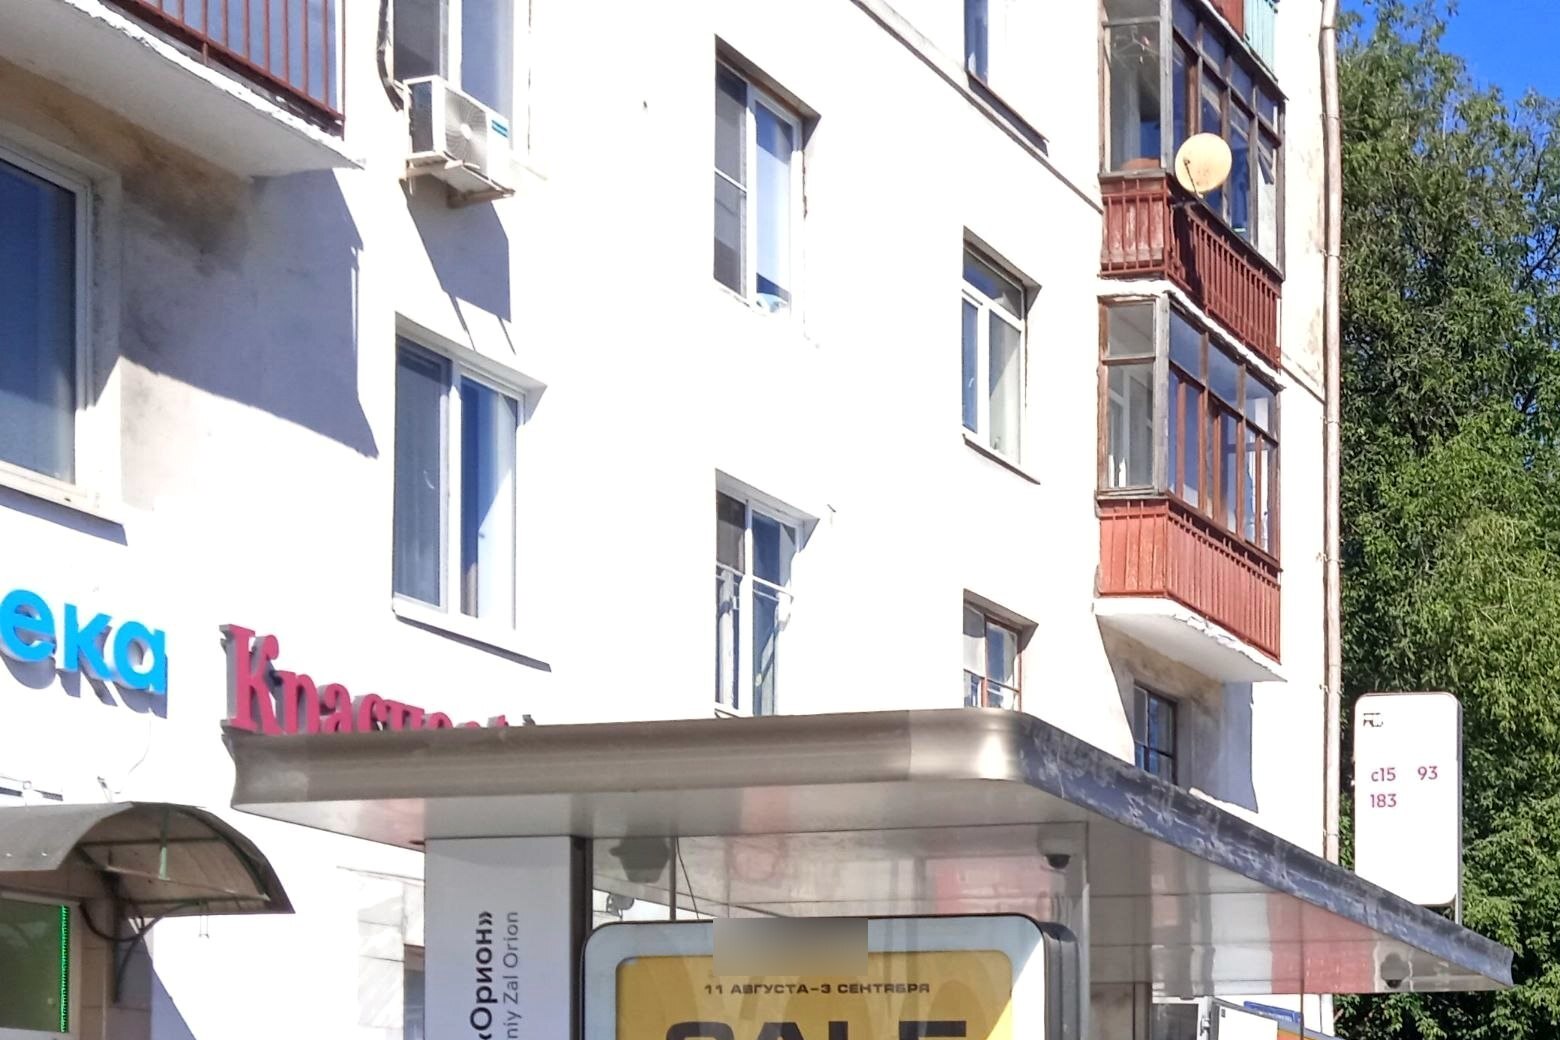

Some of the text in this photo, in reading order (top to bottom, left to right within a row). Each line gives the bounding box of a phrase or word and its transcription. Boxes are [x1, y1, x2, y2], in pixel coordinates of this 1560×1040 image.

[0, 589, 166, 694] ека
[1417, 765, 1438, 780] 93
[1370, 793, 1397, 808] 183
[503, 912, 519, 968] Orion
[503, 975, 519, 1004] Zal
[705, 984, 722, 994] 11
[838, 983, 930, 993] СЕНТЯБРЯ
